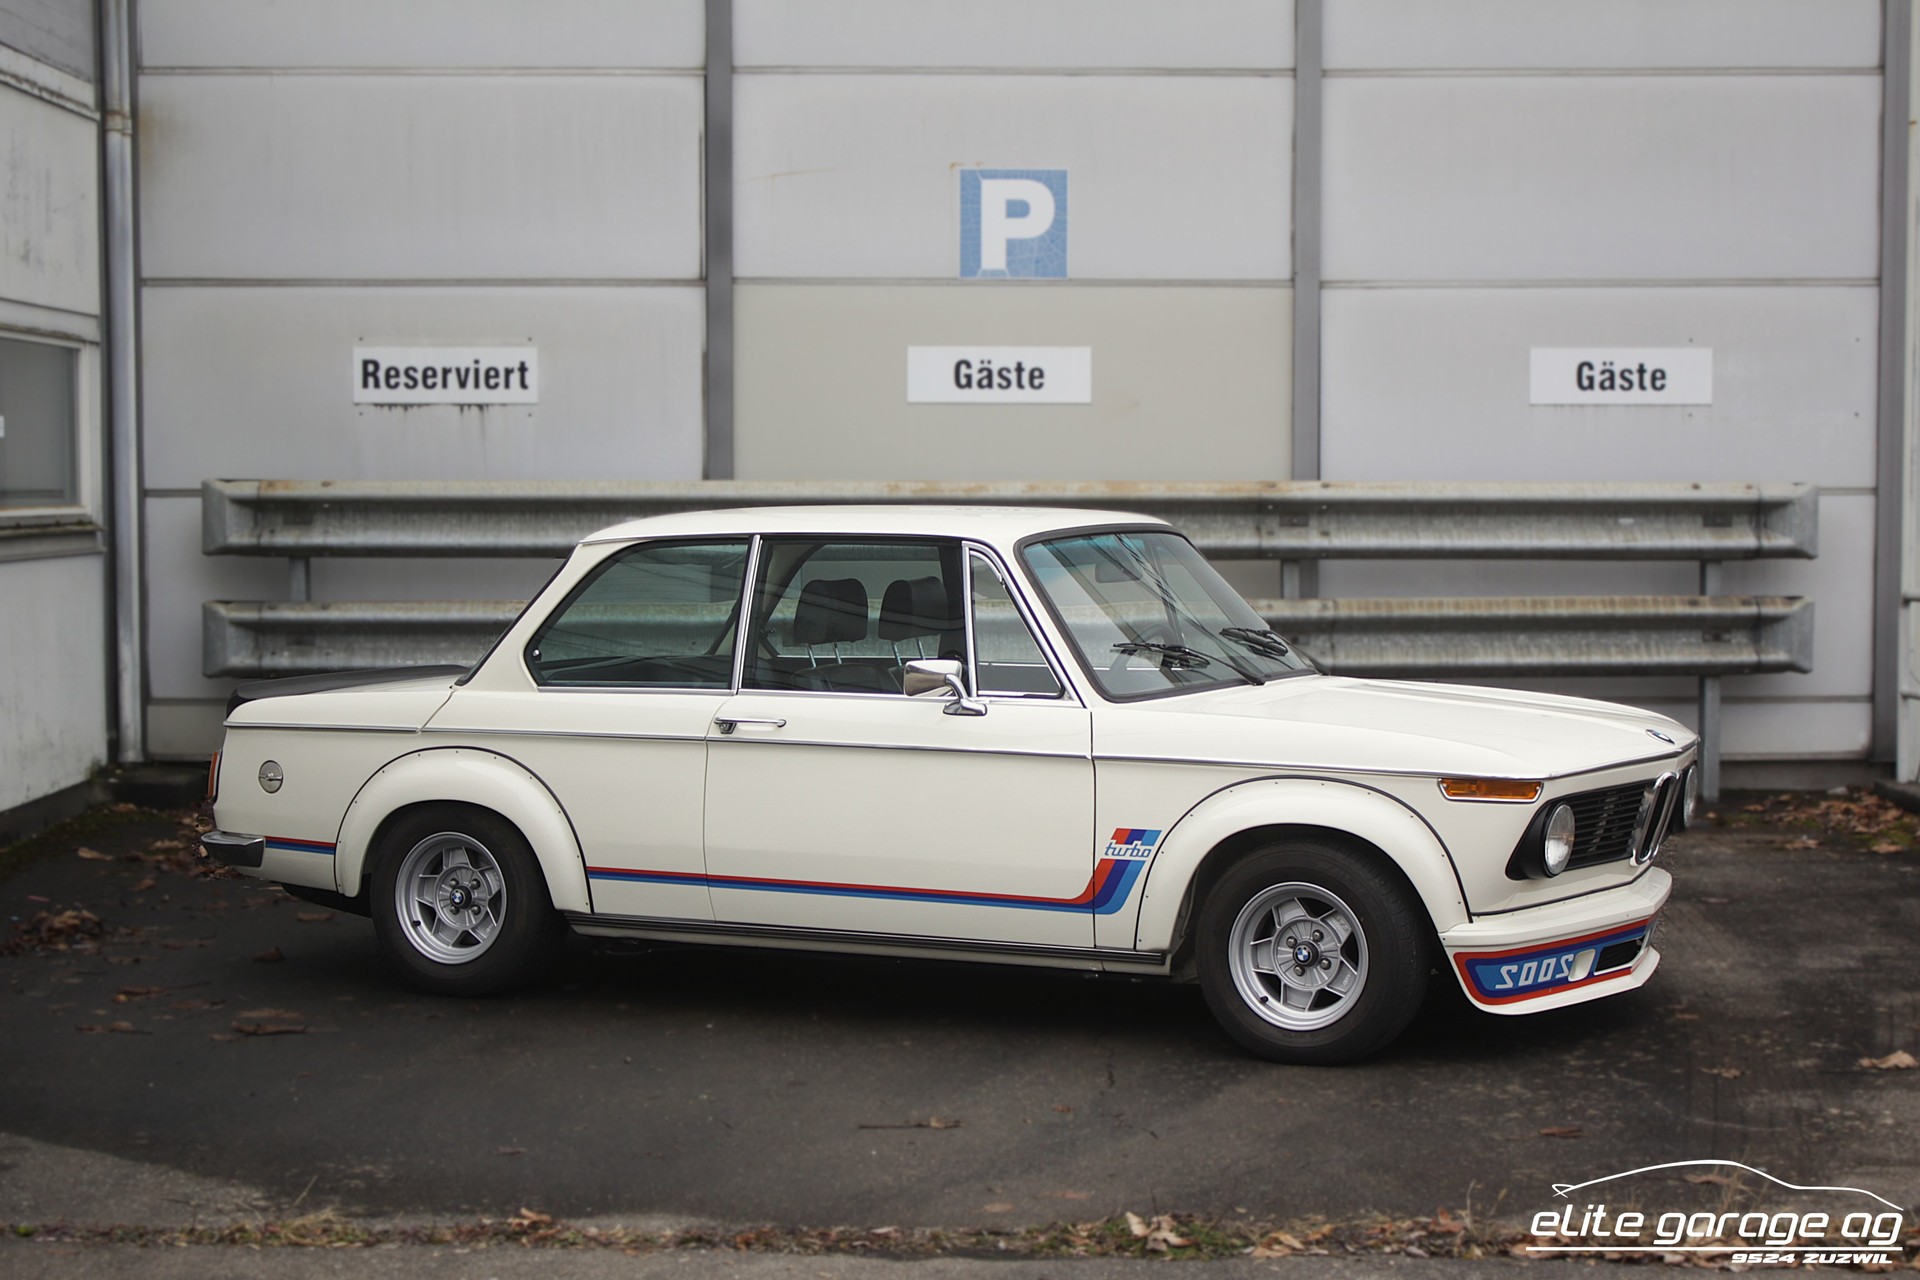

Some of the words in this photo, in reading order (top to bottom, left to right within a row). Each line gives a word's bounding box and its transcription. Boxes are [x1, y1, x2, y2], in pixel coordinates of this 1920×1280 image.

[982, 179, 1055, 270] P
[361, 359, 529, 390] Reserviert
[954, 359, 1044, 390] Gäste
[1576, 361, 1666, 391] Gäste
[1104, 841, 1152, 858] turbo
